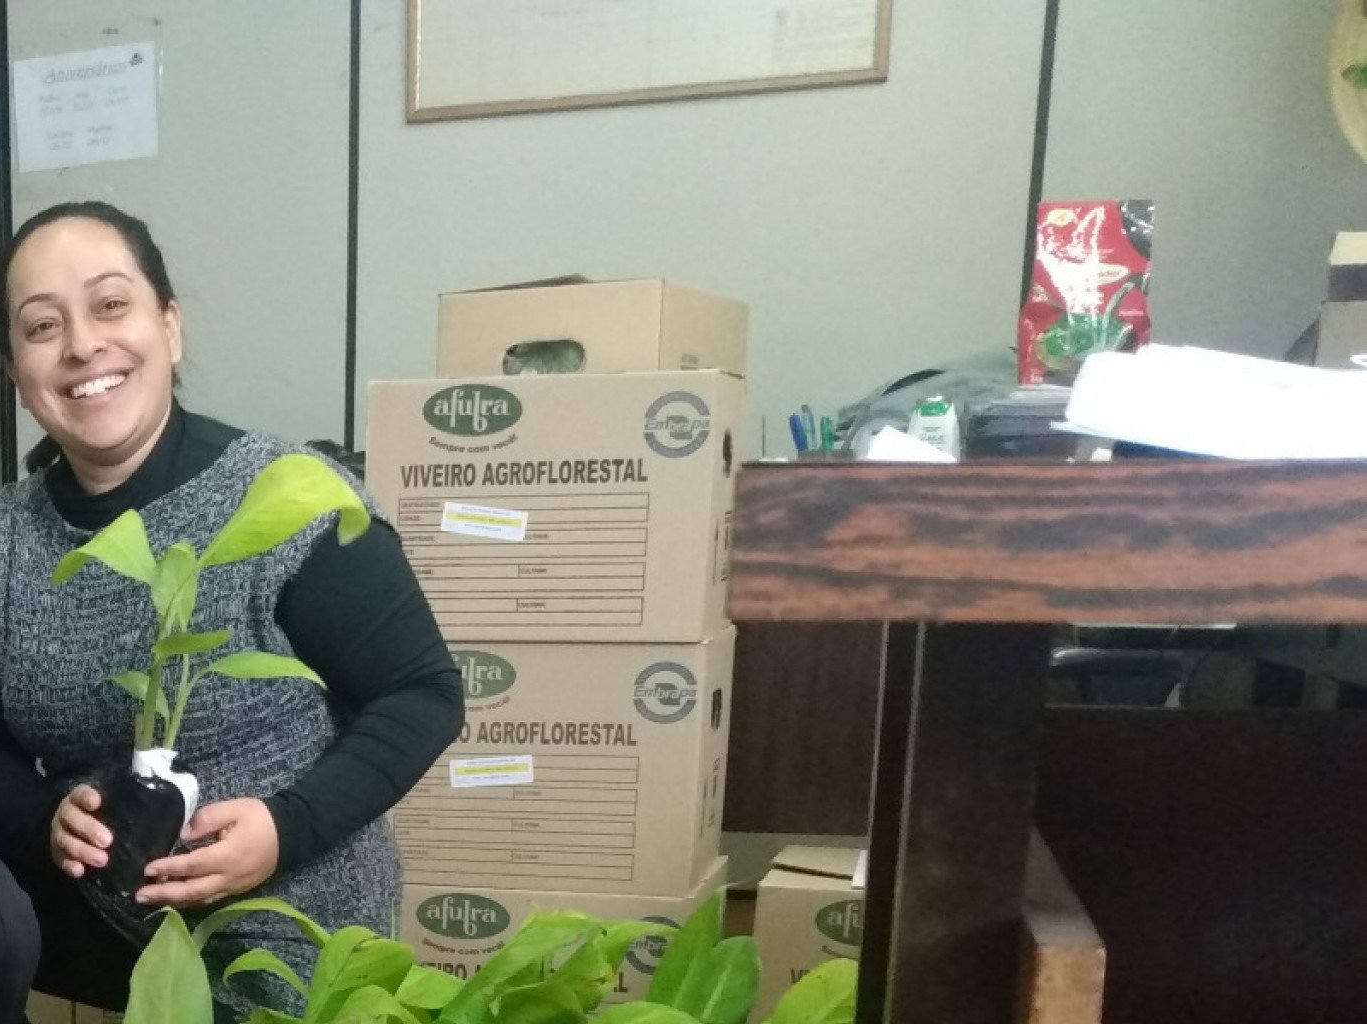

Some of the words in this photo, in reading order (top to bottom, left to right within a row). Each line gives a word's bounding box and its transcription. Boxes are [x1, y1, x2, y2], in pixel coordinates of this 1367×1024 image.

[434, 389, 510, 433] afubra
[400, 463, 476, 488] VIVEIRO
[482, 458, 649, 486] AGROFLORESTAL
[476, 721, 638, 747] AGROFLORESTAL
[426, 896, 497, 936] afubra
